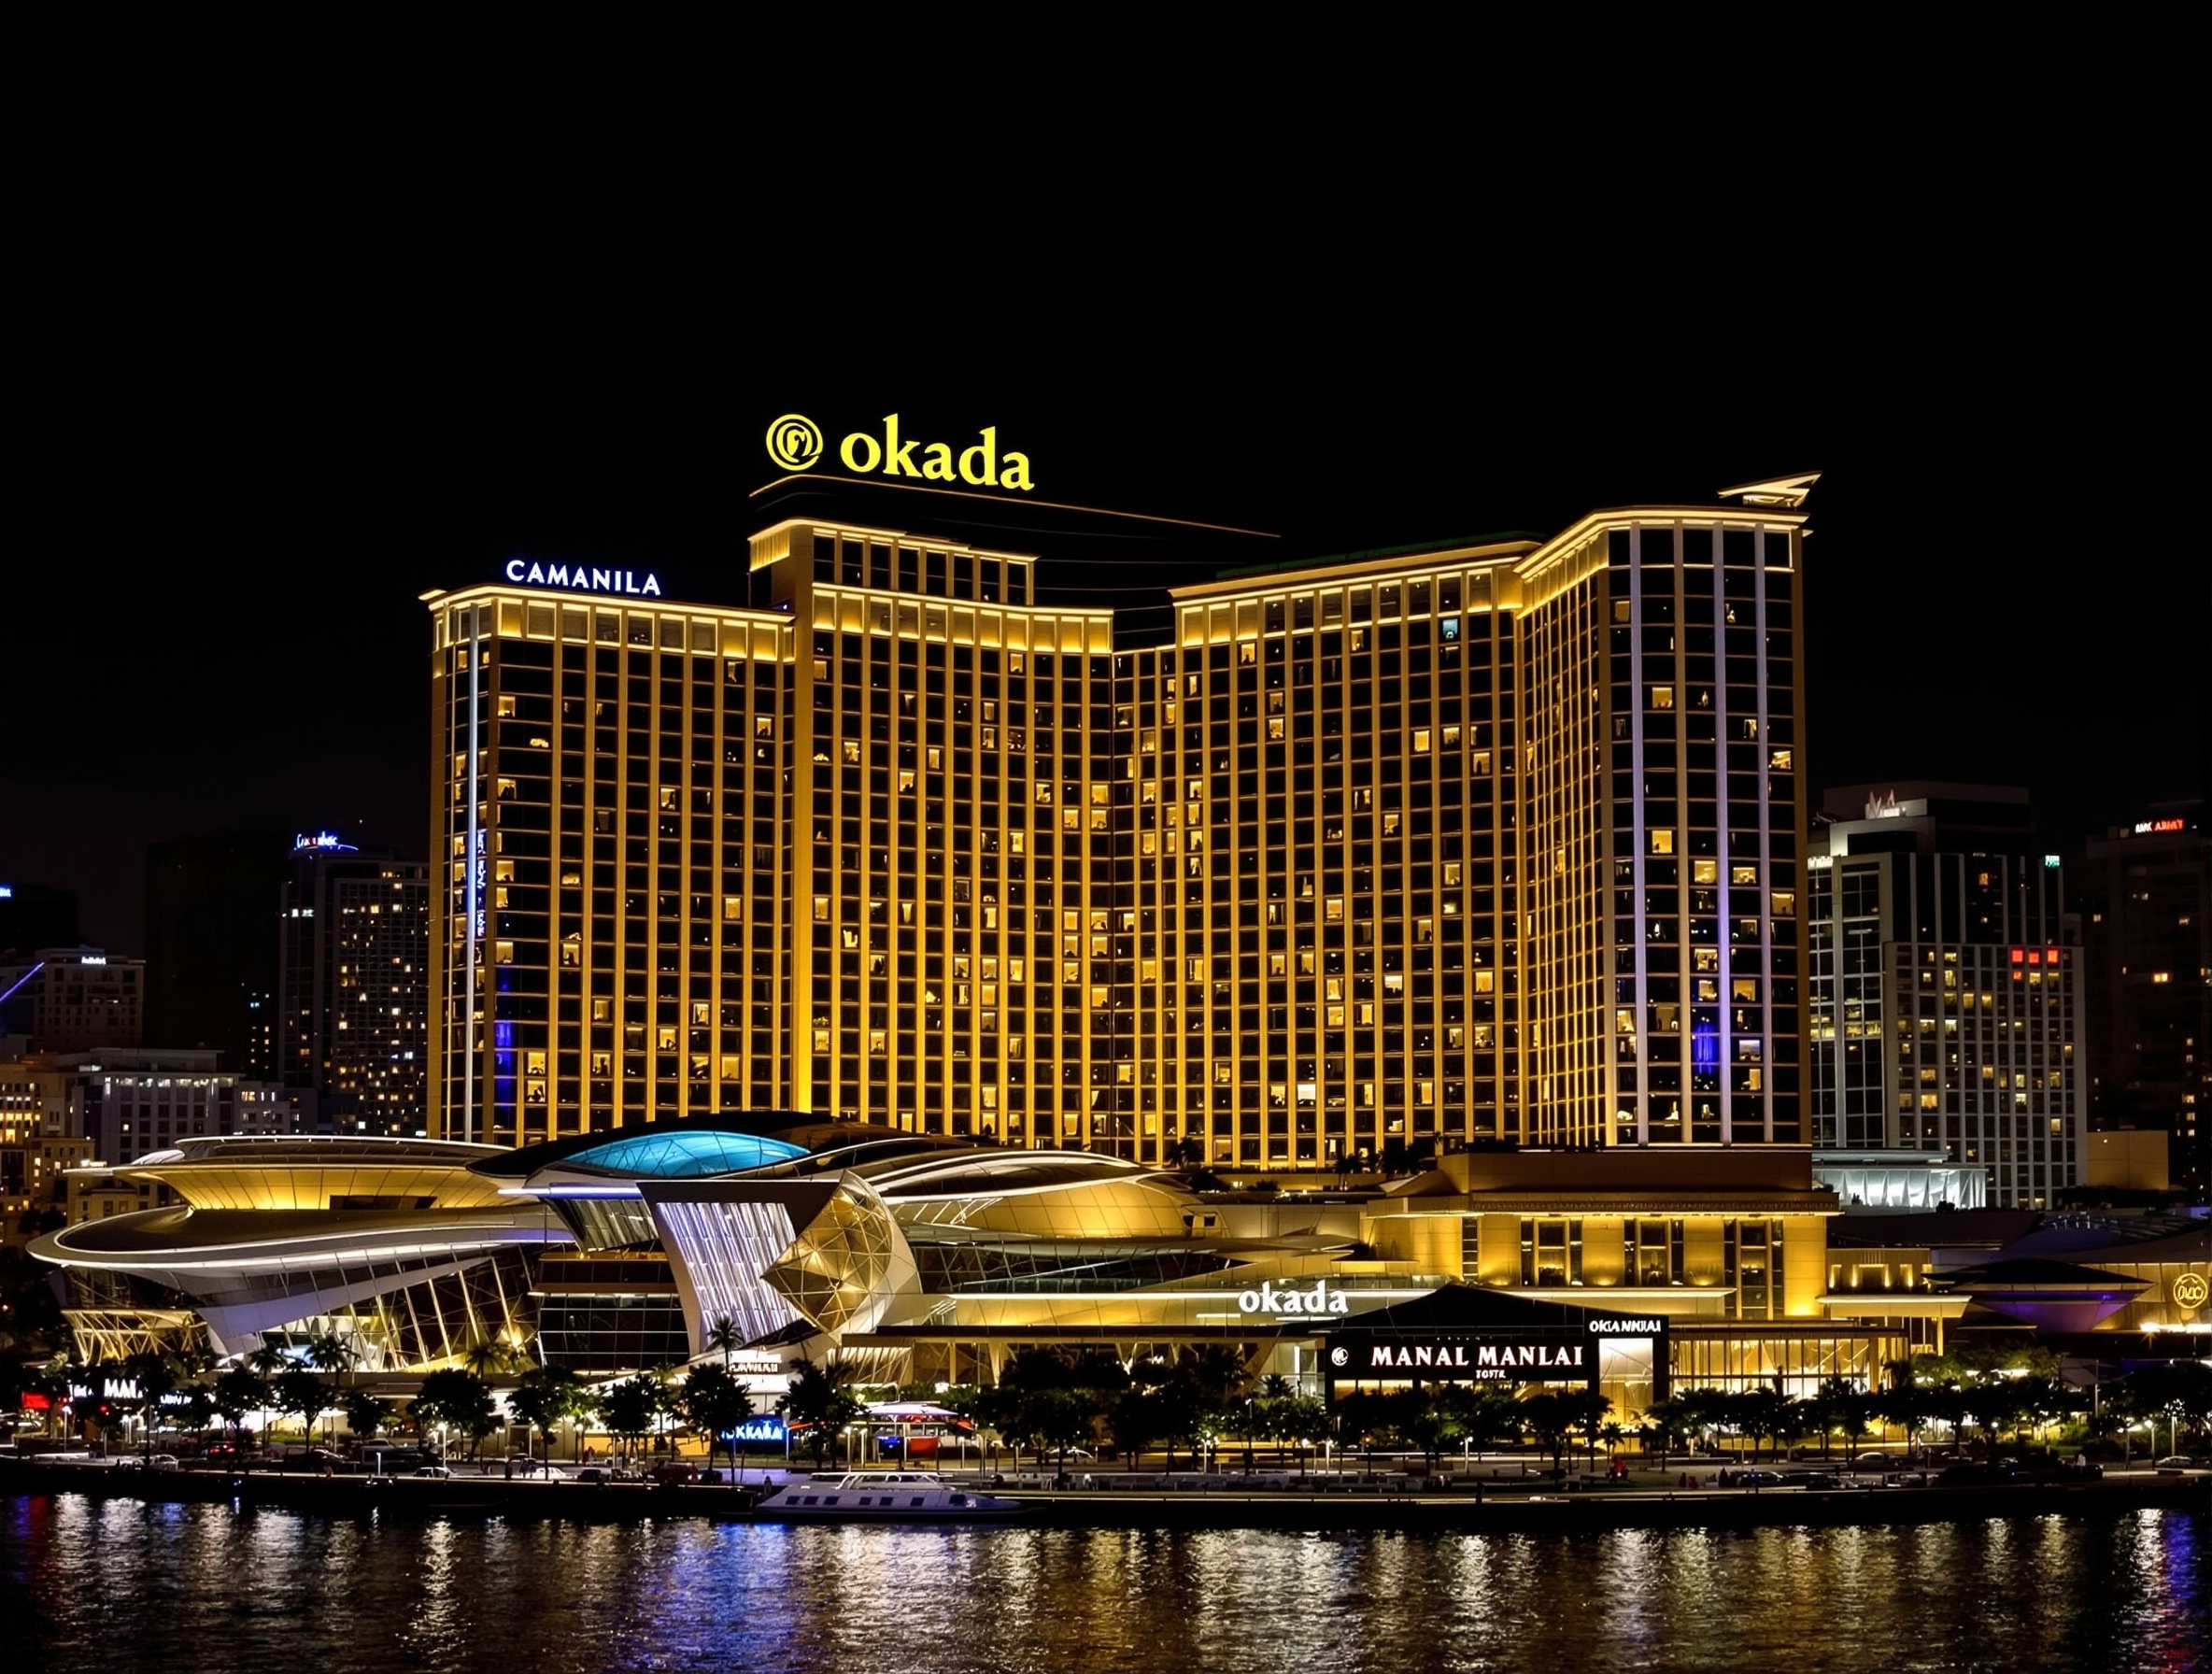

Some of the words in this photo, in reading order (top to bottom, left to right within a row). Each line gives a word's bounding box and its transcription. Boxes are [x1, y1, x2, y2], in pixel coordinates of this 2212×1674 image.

[840, 413, 1035, 490] okada
[506, 560, 661, 596] CAMANILA
[1239, 1279, 1349, 1313] okada
[1370, 1346, 1469, 1367] MANAL
[1478, 1346, 1583, 1367] MANLAI
